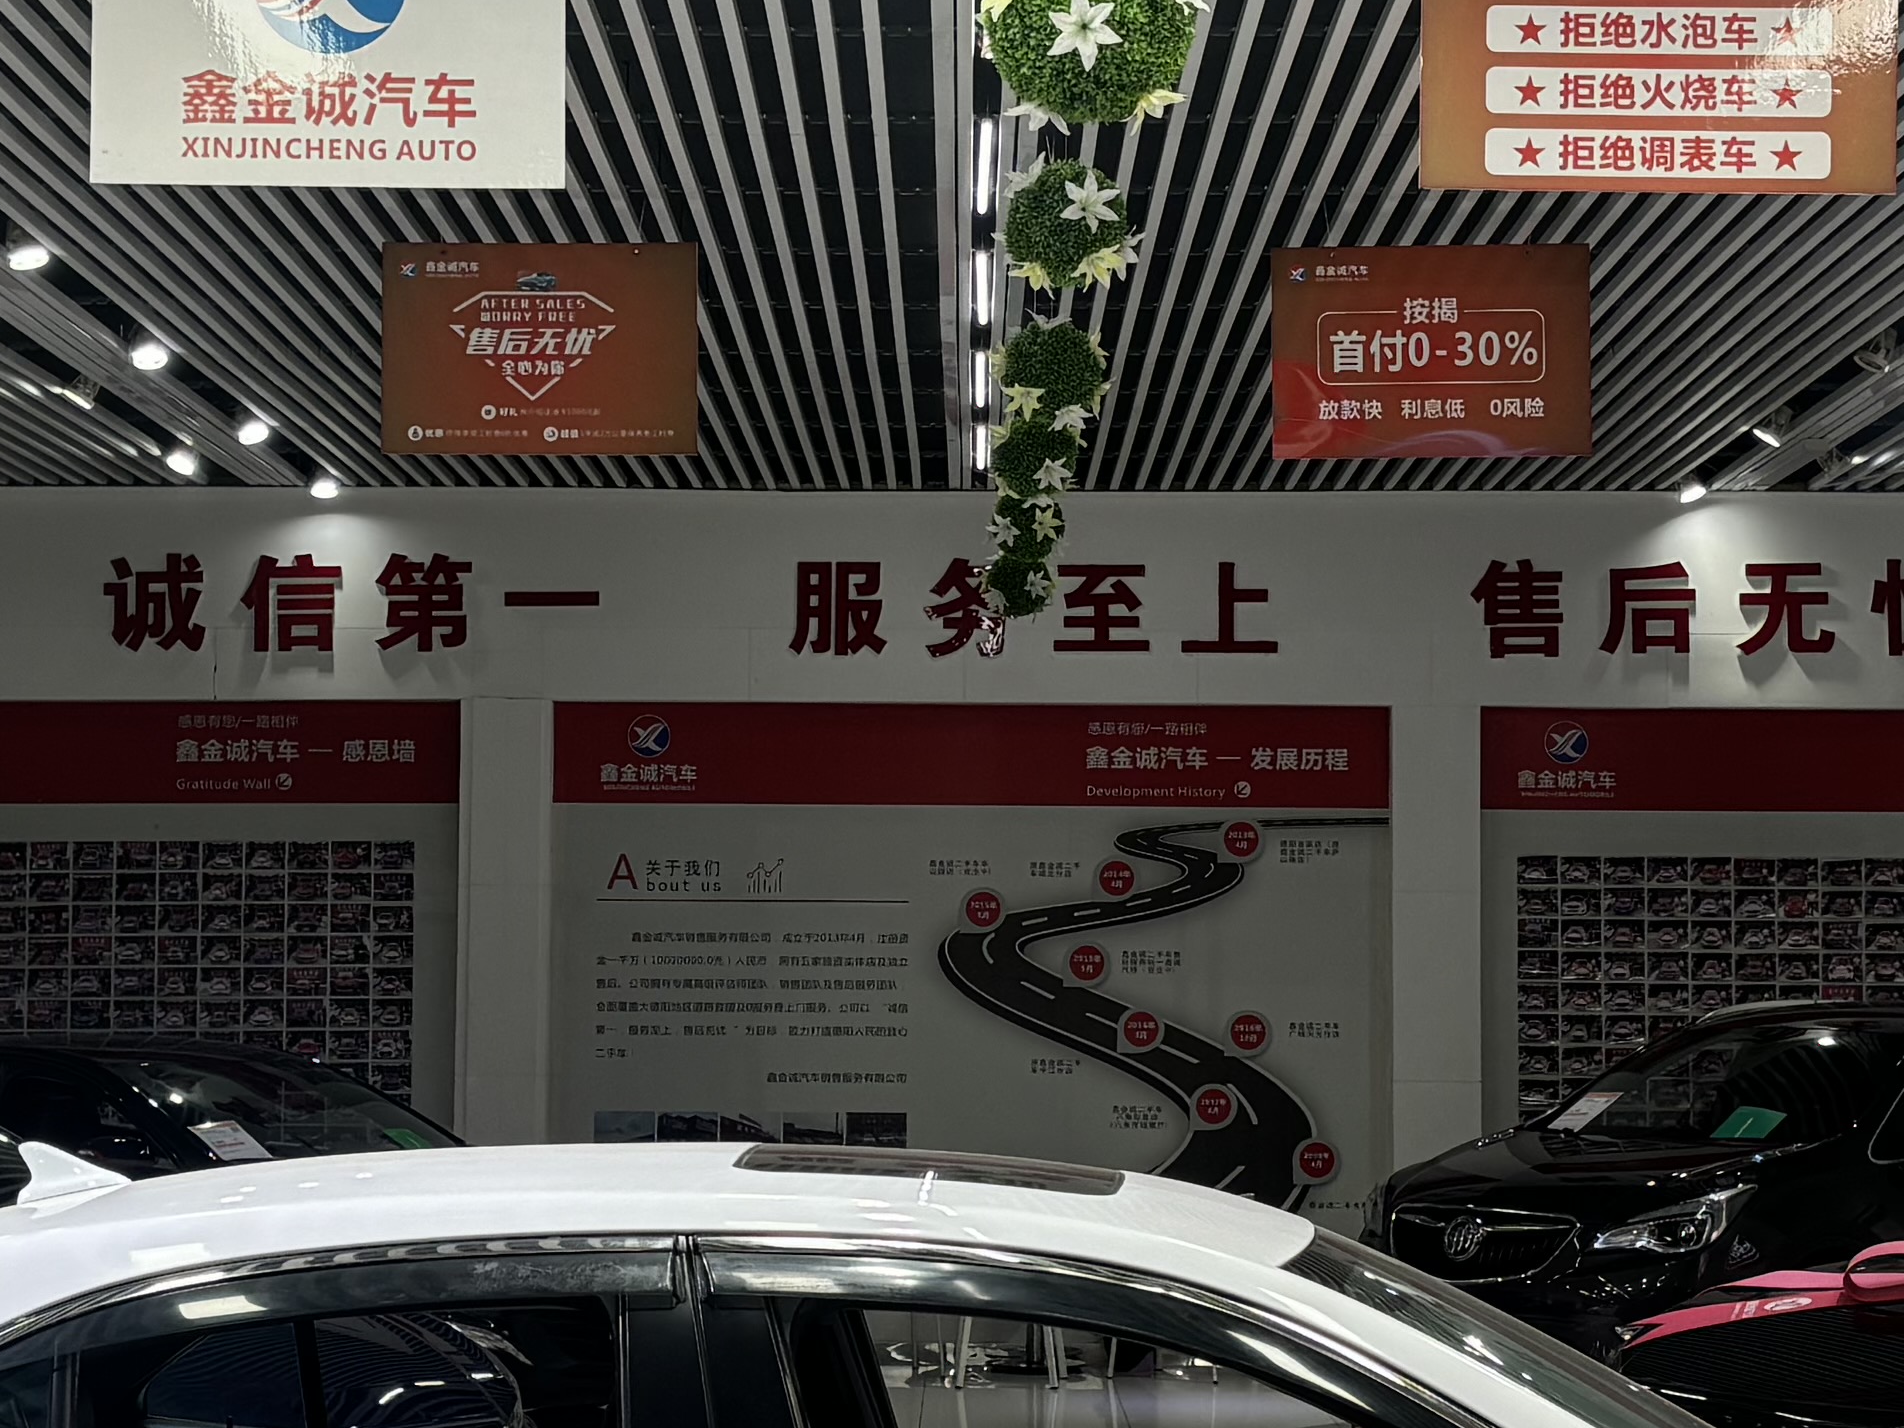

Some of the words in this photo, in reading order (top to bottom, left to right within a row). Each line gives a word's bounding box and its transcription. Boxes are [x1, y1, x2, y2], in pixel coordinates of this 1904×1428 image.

[1559, 11, 1758, 50] 拒绝水泡车
[181, 69, 477, 129] 鑫金诚汽车
[1559, 73, 1758, 112] 拒绝火烧车
[181, 136, 387, 160] XINJINCHENG
[396, 139, 477, 161] AUTO
[1558, 134, 1757, 173] 拒绝调表车
[480, 298, 529, 310] AFTER
[536, 298, 586, 310] SALES
[1403, 297, 1458, 325] 按揭
[537, 311, 577, 323] FREE
[465, 327, 596, 355] 售后无忧
[1329, 330, 1538, 373] 首付0-30%
[1318, 399, 1383, 420] 放款快
[1400, 398, 1466, 420] 利息低
[1490, 397, 1545, 418] 0风险
[104, 551, 599, 655] 诚信第一
[789, 559, 1280, 657] 服务至上
[175, 739, 300, 763] 鑫金诚汽车
[341, 739, 416, 763] 感恩墙
[1085, 746, 1209, 771] 鑫金诚汽车
[1250, 747, 1349, 771] 发展历程
[176, 778, 239, 791] Gratitude
[243, 778, 271, 790] Wall
[600, 763, 698, 783] 鑫金诚汽车
[1517, 770, 1617, 789] 鑫金诚汽车
[1086, 784, 1174, 799] Development
[1178, 784, 1226, 800] History
[645, 859, 721, 878] 关于我们
[701, 880, 722, 892] us
